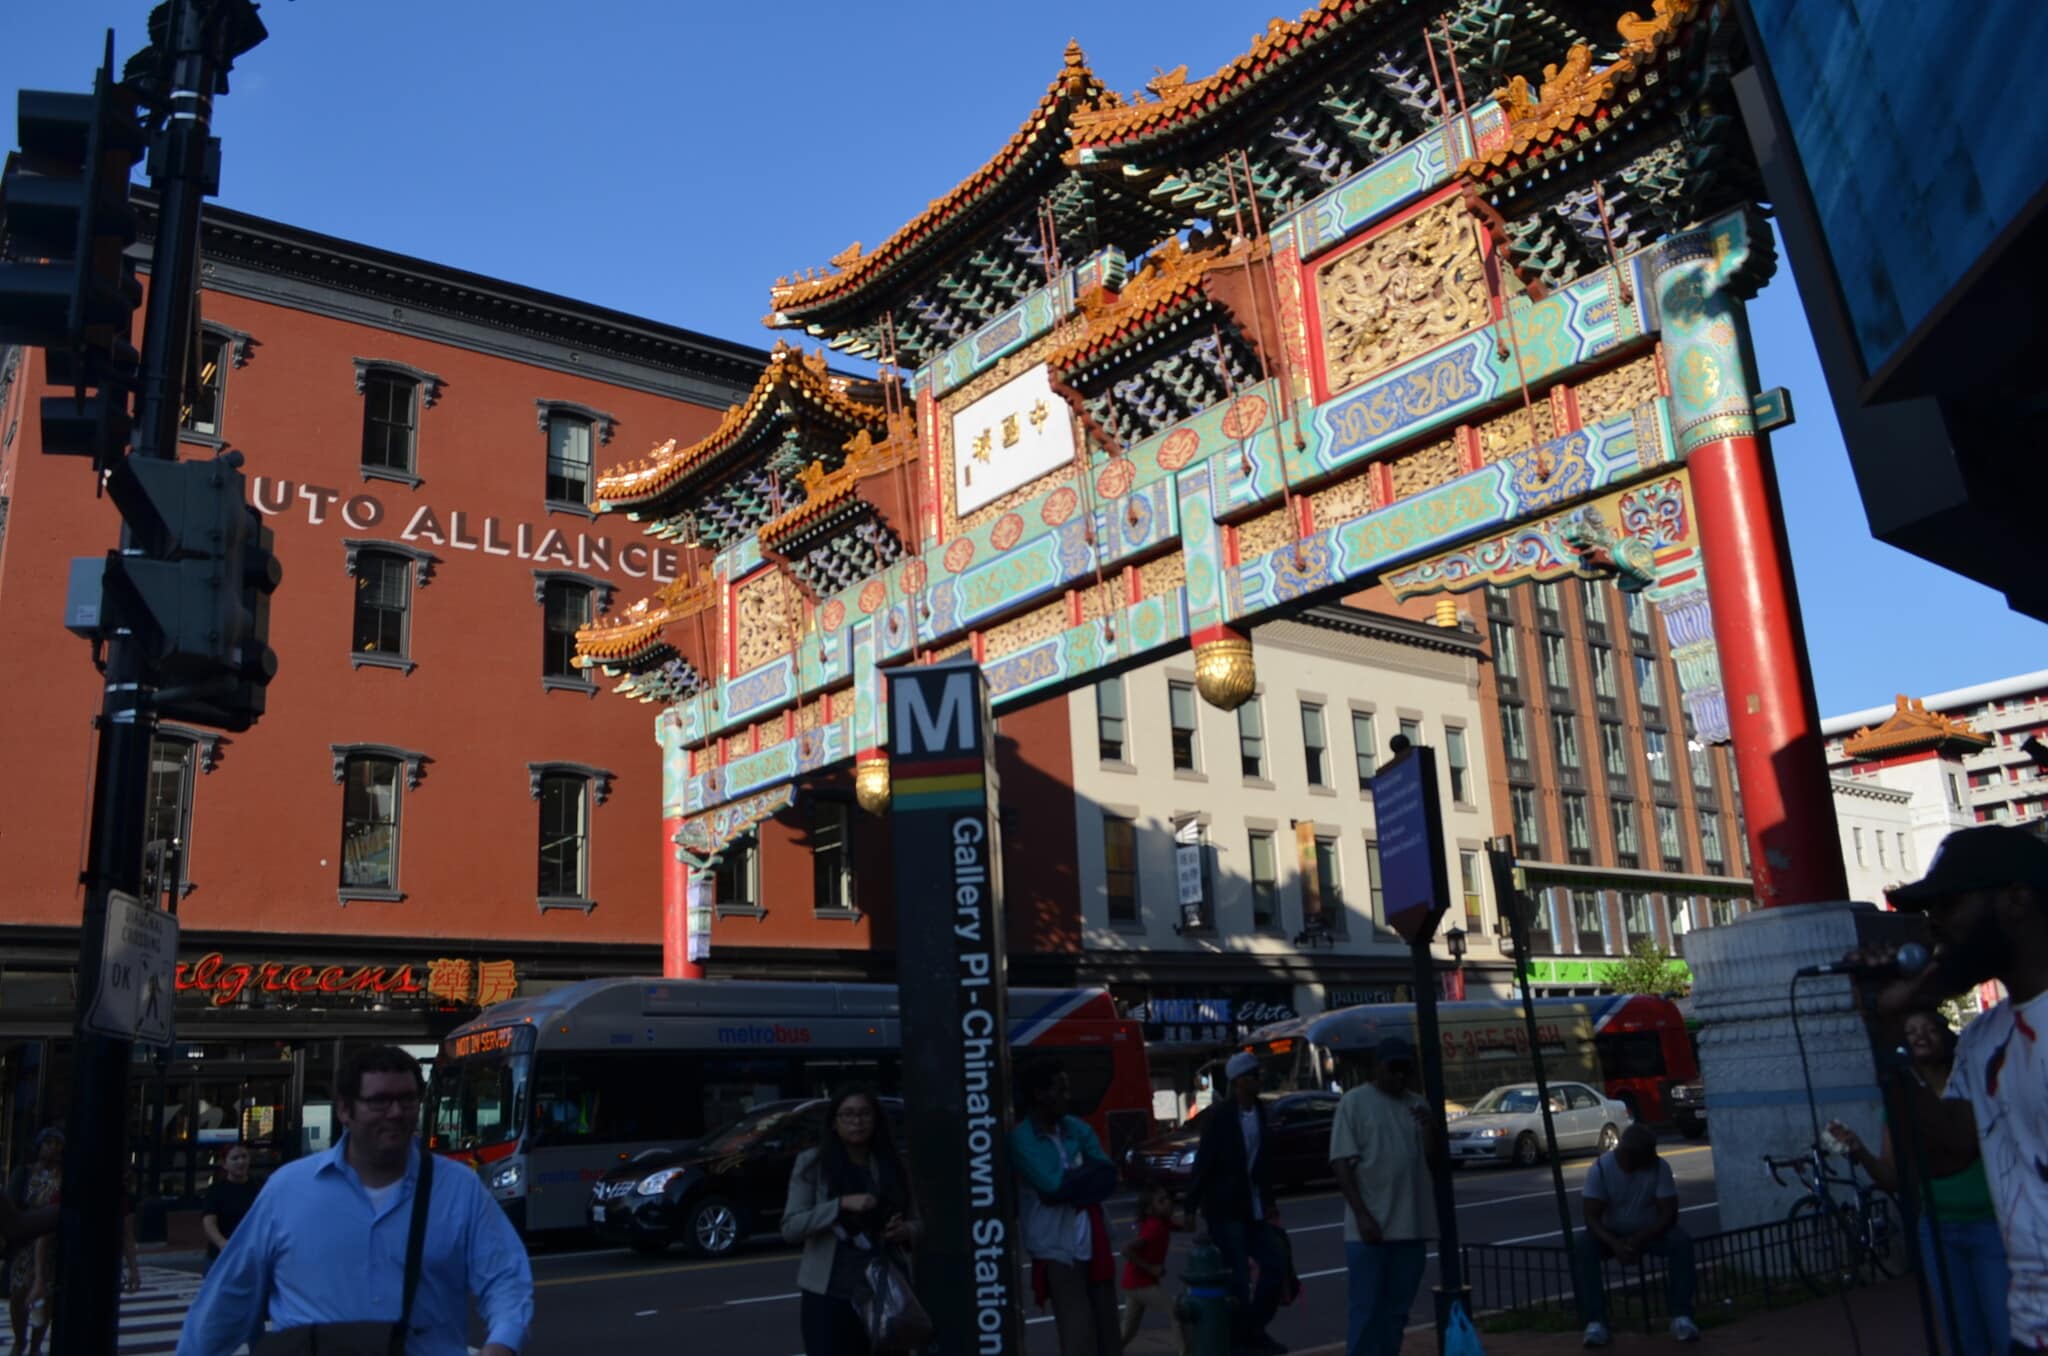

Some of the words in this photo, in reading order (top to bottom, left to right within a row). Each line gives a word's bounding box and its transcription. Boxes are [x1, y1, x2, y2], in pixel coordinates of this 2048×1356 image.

[252, 476, 384, 530] UTO
[401, 505, 679, 583] ALLIANCE
[894, 672, 975, 756] M
[719, 1024, 811, 1043] metrobus
[952, 816, 986, 942] Gallery
[972, 1218, 1008, 1356] Station
